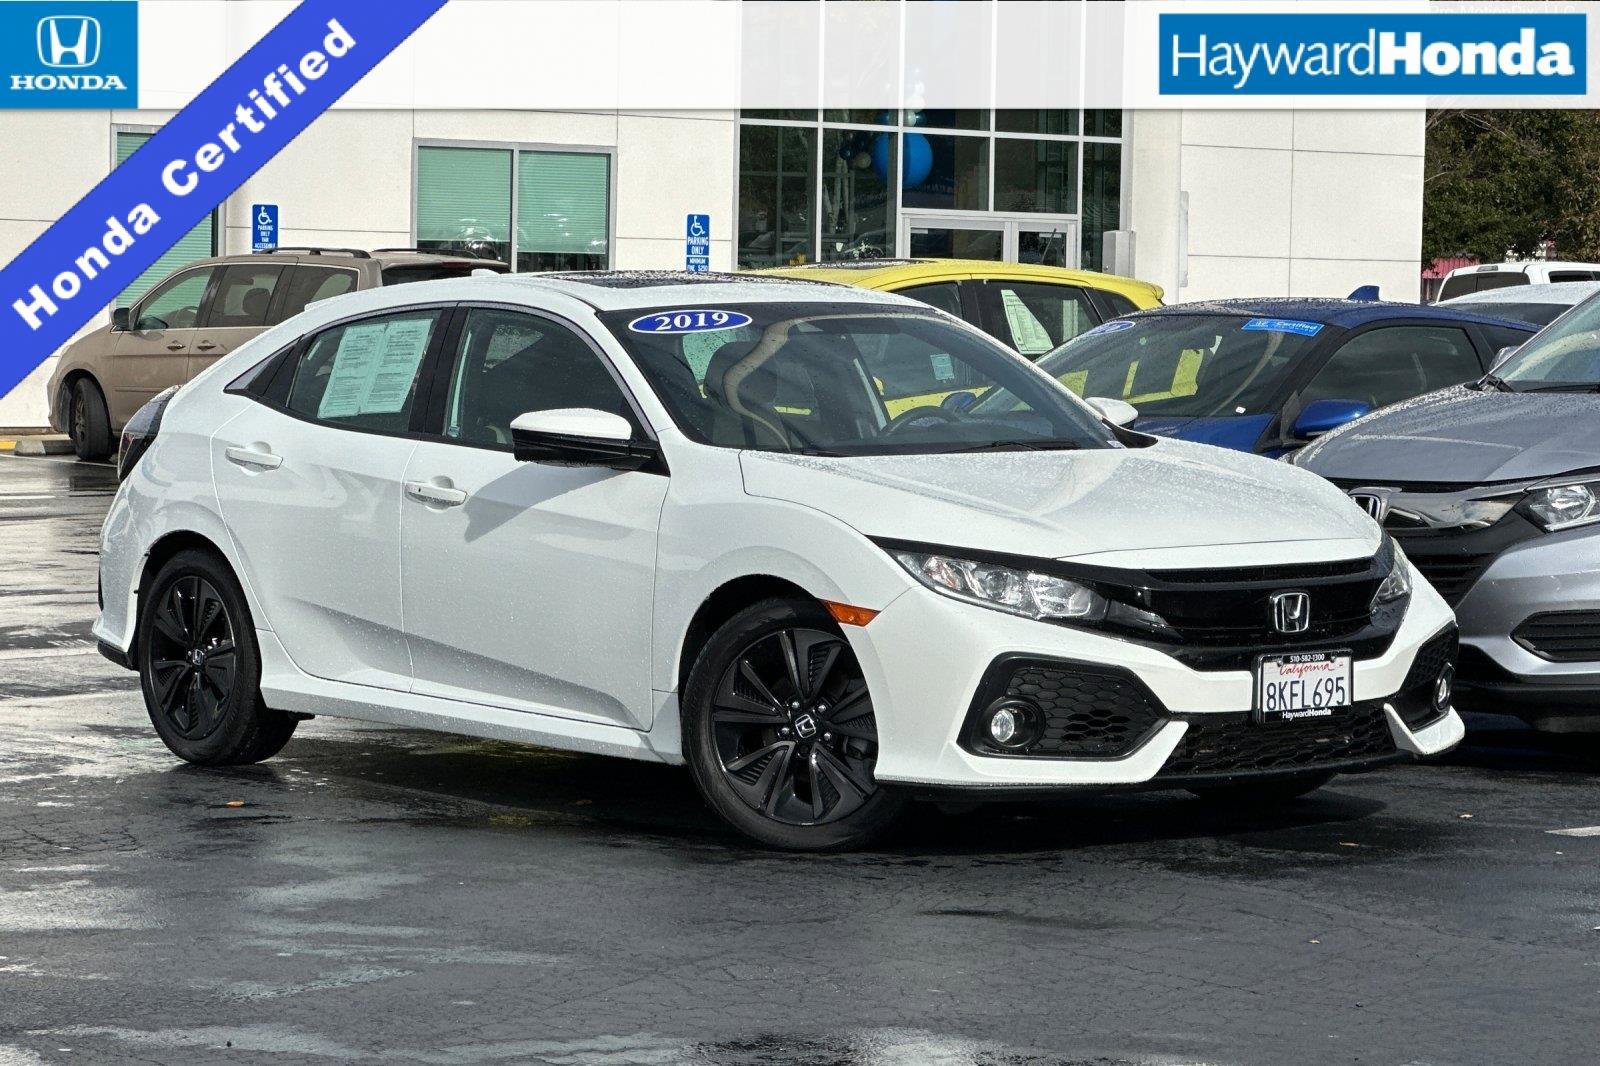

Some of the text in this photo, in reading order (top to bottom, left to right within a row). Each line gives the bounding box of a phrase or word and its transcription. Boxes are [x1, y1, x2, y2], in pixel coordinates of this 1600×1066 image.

[687, 236, 709, 246] PARKING
[691, 246, 705, 255] ONLY
[654, 312, 729, 331] 2019
[1290, 654, 1325, 662] 510-582-1300
[1279, 662, 1336, 678] California
[1266, 677, 1345, 711] 8KFL695
